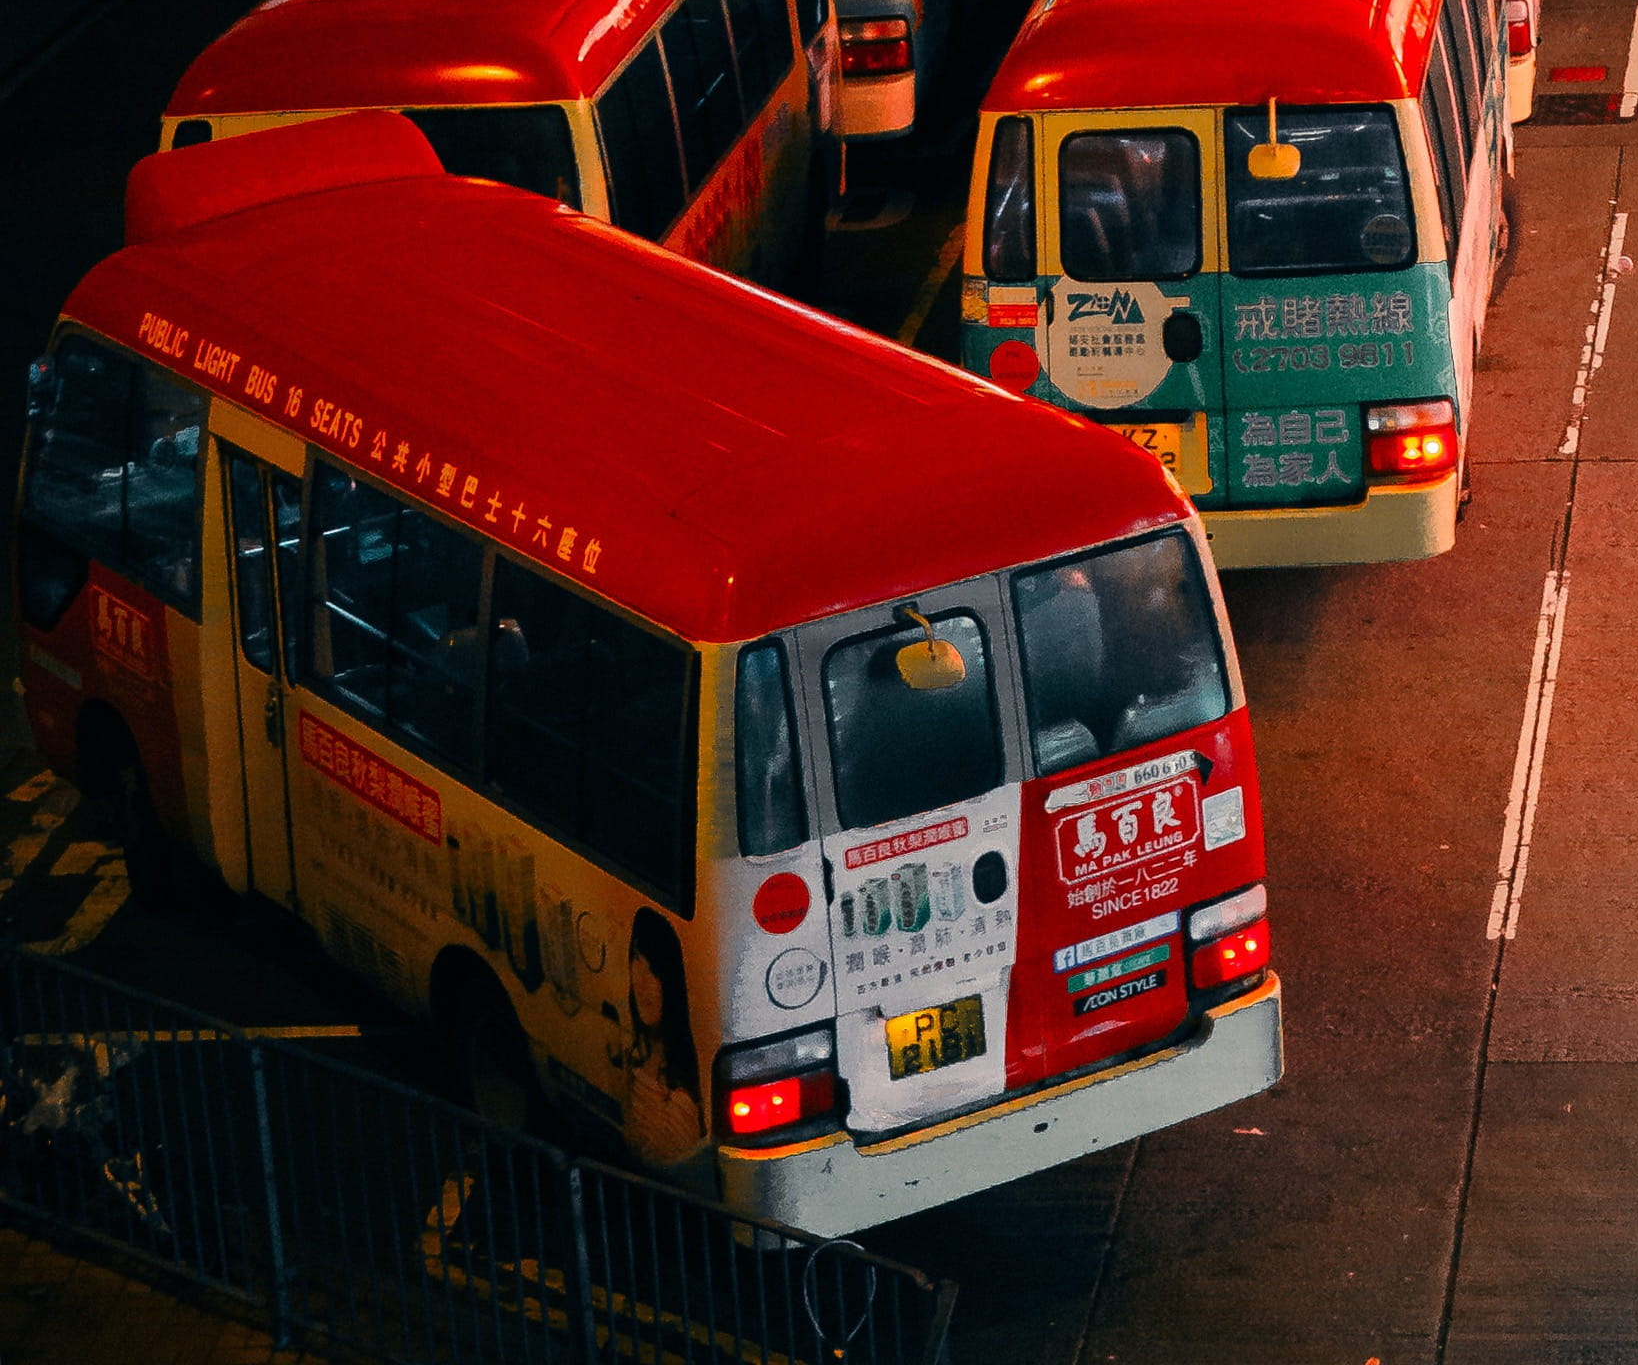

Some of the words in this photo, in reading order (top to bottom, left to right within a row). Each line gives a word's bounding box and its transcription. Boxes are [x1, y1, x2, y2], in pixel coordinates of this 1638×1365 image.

[1235, 290, 1415, 341] 戒賭熱線
[1250, 344, 1331, 373] 2703
[1338, 340, 1415, 369] 9811
[138, 312, 190, 359] PUBLIC
[193, 338, 241, 384] LIGHT
[244, 364, 278, 405] BUS
[284, 385, 303, 418] 16
[310, 398, 364, 449] SEATS
[370, 429, 602, 575] 公共小型巴士十六座位
[1073, 790, 1183, 859] 馬百良
[1074, 860, 1099, 877] MA
[1102, 849, 1132, 867] PAK
[1136, 830, 1184, 856] LEUNG
[1119, 974, 1159, 998] STYLE
